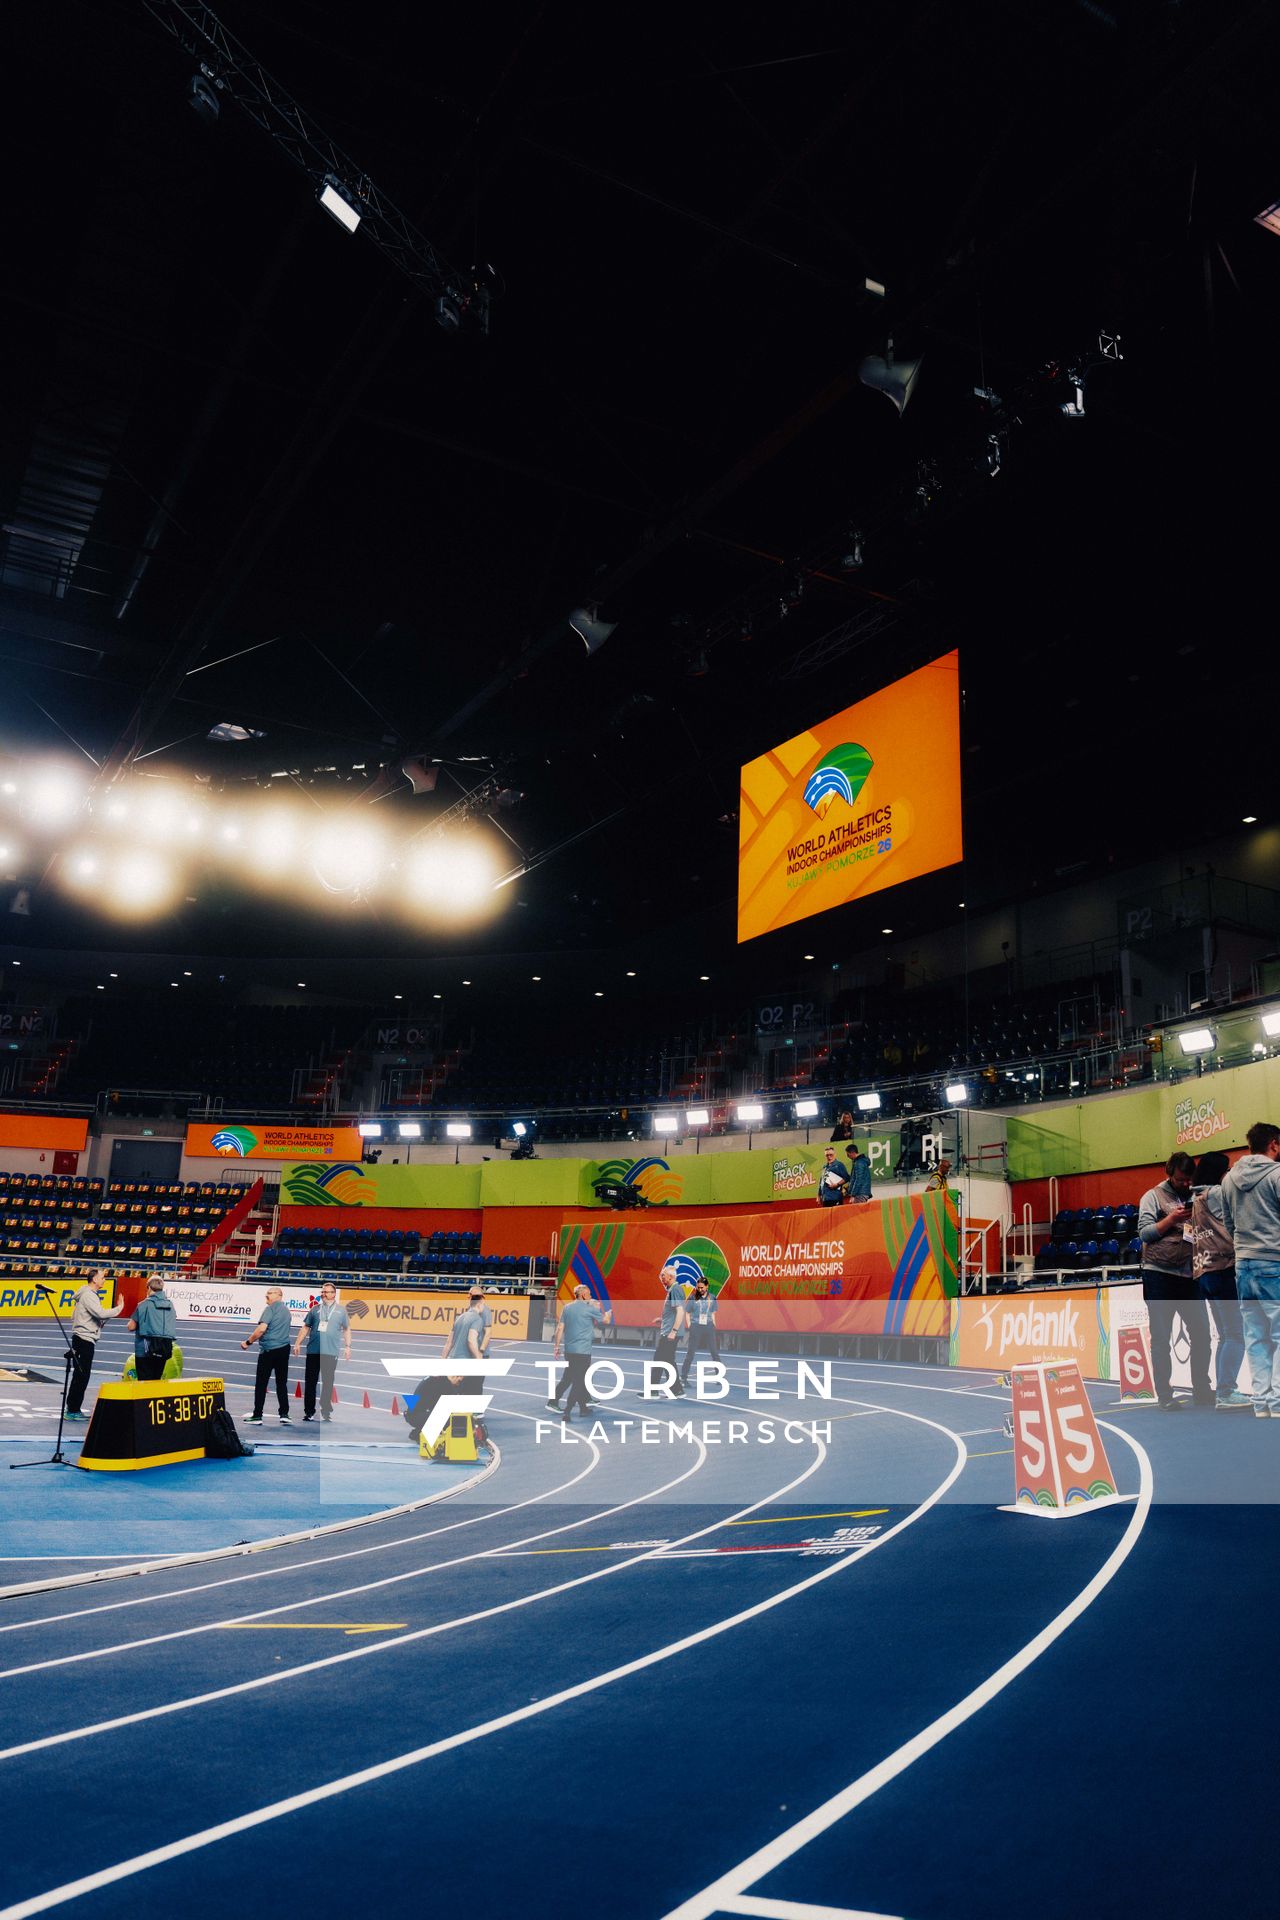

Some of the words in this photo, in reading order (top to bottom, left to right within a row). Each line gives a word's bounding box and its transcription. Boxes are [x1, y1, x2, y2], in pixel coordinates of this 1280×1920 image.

[787, 834, 826, 862] WORLD
[828, 805, 892, 845] ATHLETICS
[786, 855, 818, 876] INDOOR
[819, 822, 892, 863] CHAMPIONSHIPS
[786, 867, 824, 889] KUJAWY
[826, 844, 875, 877] POMORZE
[877, 838, 892, 854] 26
[377, 1028, 400, 1044] N2
[1175, 1098, 1192, 1116] ONE
[1175, 1100, 1215, 1133] TRACK
[264, 1132, 292, 1140] WORLD
[294, 1132, 334, 1141] ATHLETICS
[921, 1132, 943, 1163] R1
[773, 1159, 788, 1170] ONE
[867, 1140, 891, 1168] P1
[774, 1163, 806, 1183] TRACK
[740, 1244, 782, 1262] WORLD
[784, 1240, 845, 1260] ATHLETICS
[739, 1264, 773, 1278] INDOOR
[773, 1262, 844, 1277] CHAMPIONSHIPS
[165, 1288, 234, 1302] Ubezpieczamy
[829, 1279, 843, 1295] 26
[0, 1290, 45, 1307] RMF
[189, 1303, 202, 1313] to,
[205, 1305, 216, 1313] co
[219, 1304, 252, 1316] ważne
[375, 1304, 431, 1321] WORLD
[433, 1306, 519, 1326] ATHICS
[1000, 1298, 1080, 1356] polanik
[1123, 1349, 1145, 1385] 6
[202, 1381, 223, 1393] SEIKO
[148, 1395, 214, 1425] 16:38:07
[1019, 1410, 1046, 1478] 5
[1056, 1403, 1095, 1474] 5
